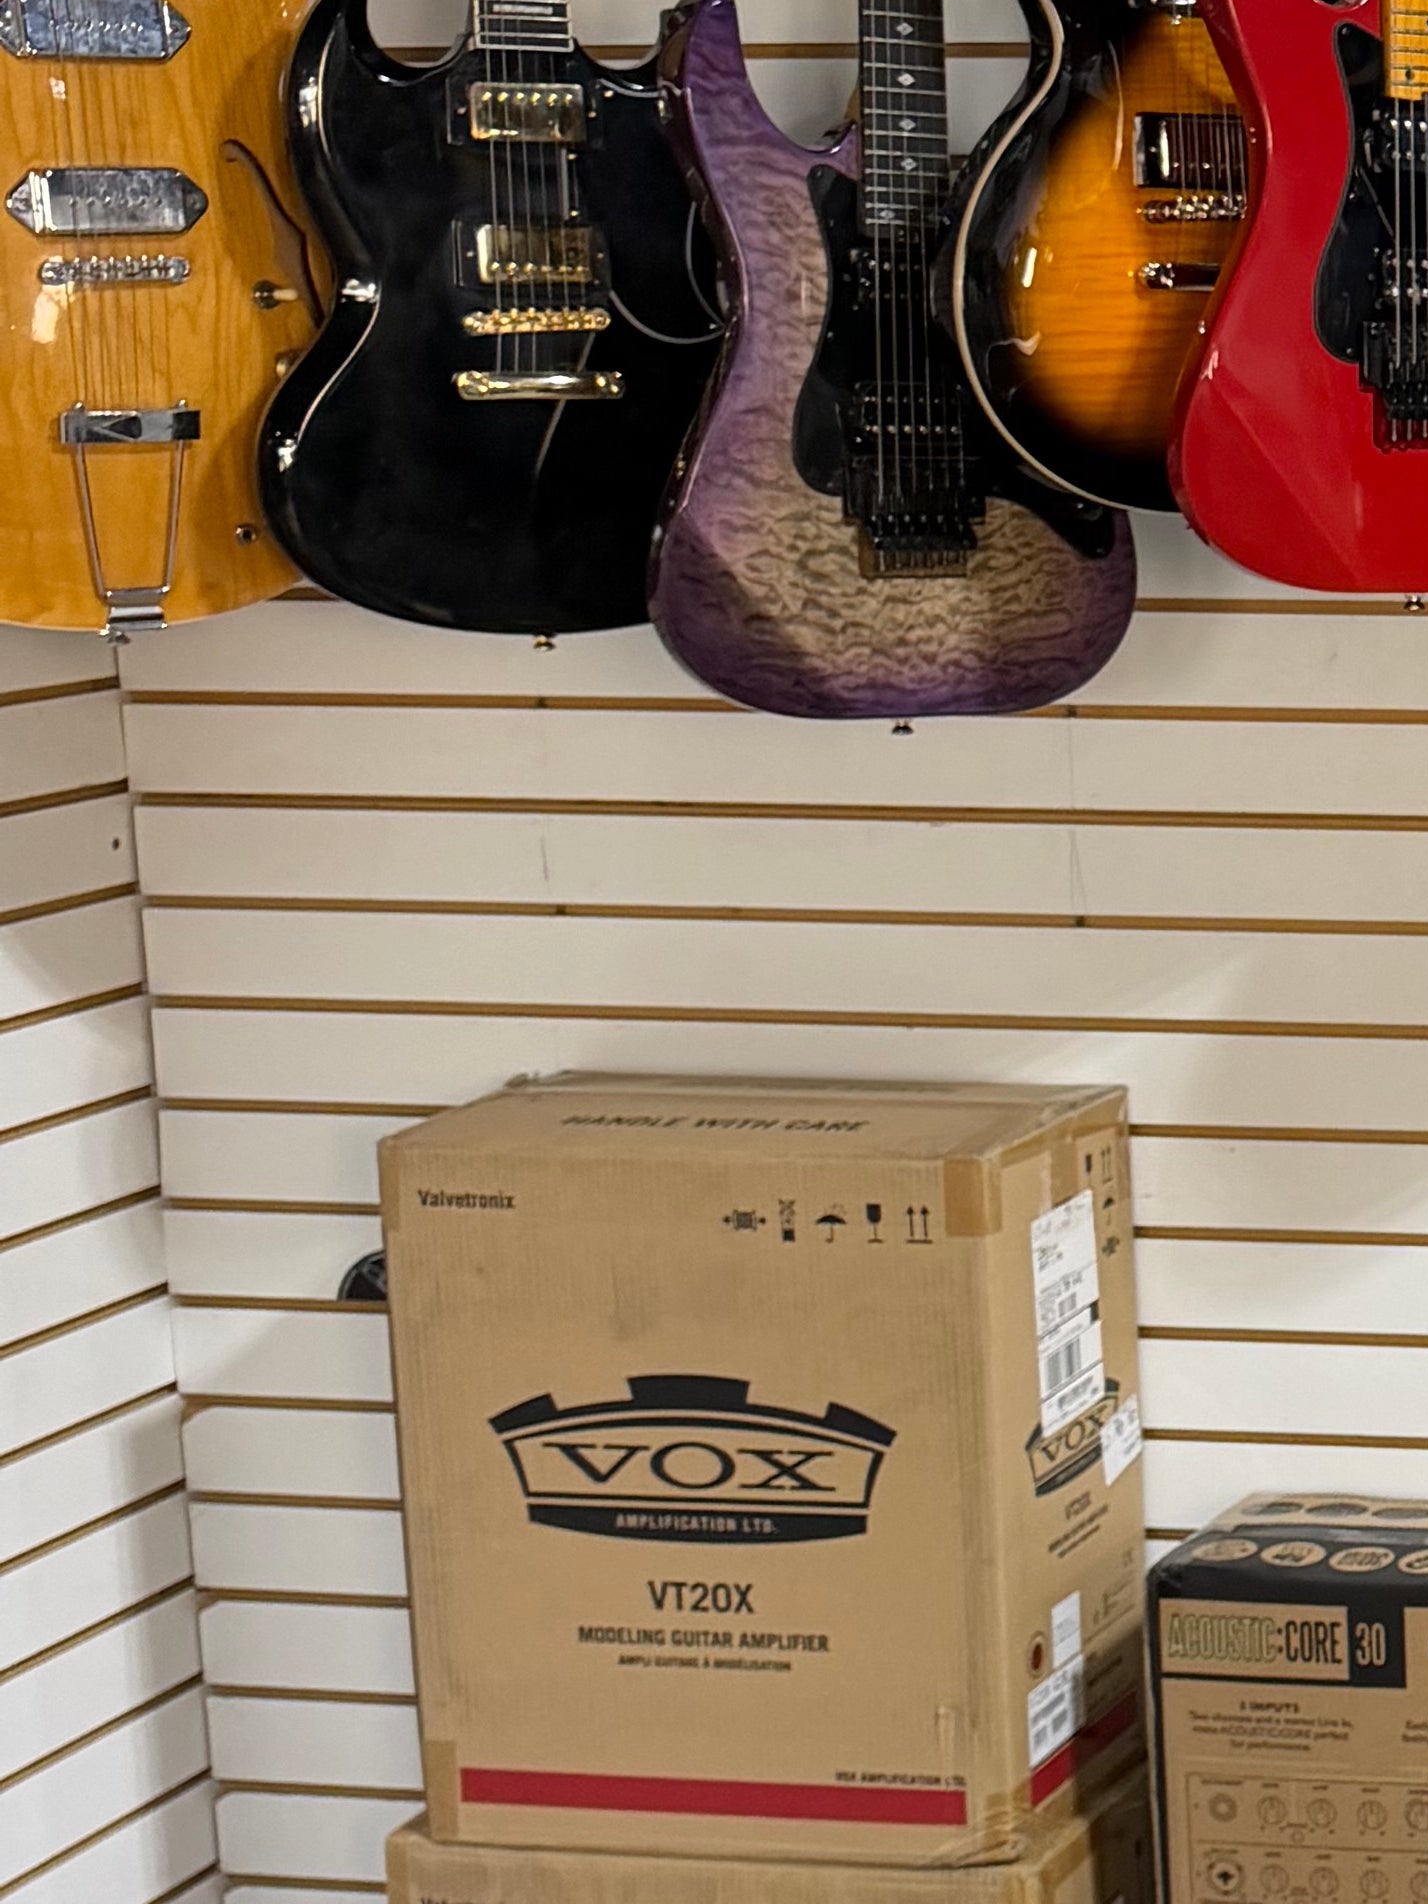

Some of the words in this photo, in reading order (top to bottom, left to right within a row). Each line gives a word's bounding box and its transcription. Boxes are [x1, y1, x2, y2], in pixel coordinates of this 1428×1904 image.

[561, 1114, 689, 1127] HANDLE
[694, 1117, 778, 1132] WITH
[783, 1118, 870, 1134] CARE
[417, 1188, 516, 1210] Valvetronix
[1039, 1405, 1108, 1464] VOX
[542, 1440, 836, 1492] VOX
[615, 1514, 737, 1533] AMPLIFICATION
[647, 1579, 755, 1616] VT20X
[578, 1625, 667, 1646] MODELING
[670, 1629, 734, 1648] GUITAR
[738, 1632, 830, 1653] AMPLIFIER
[1355, 1622, 1387, 1667] 30
